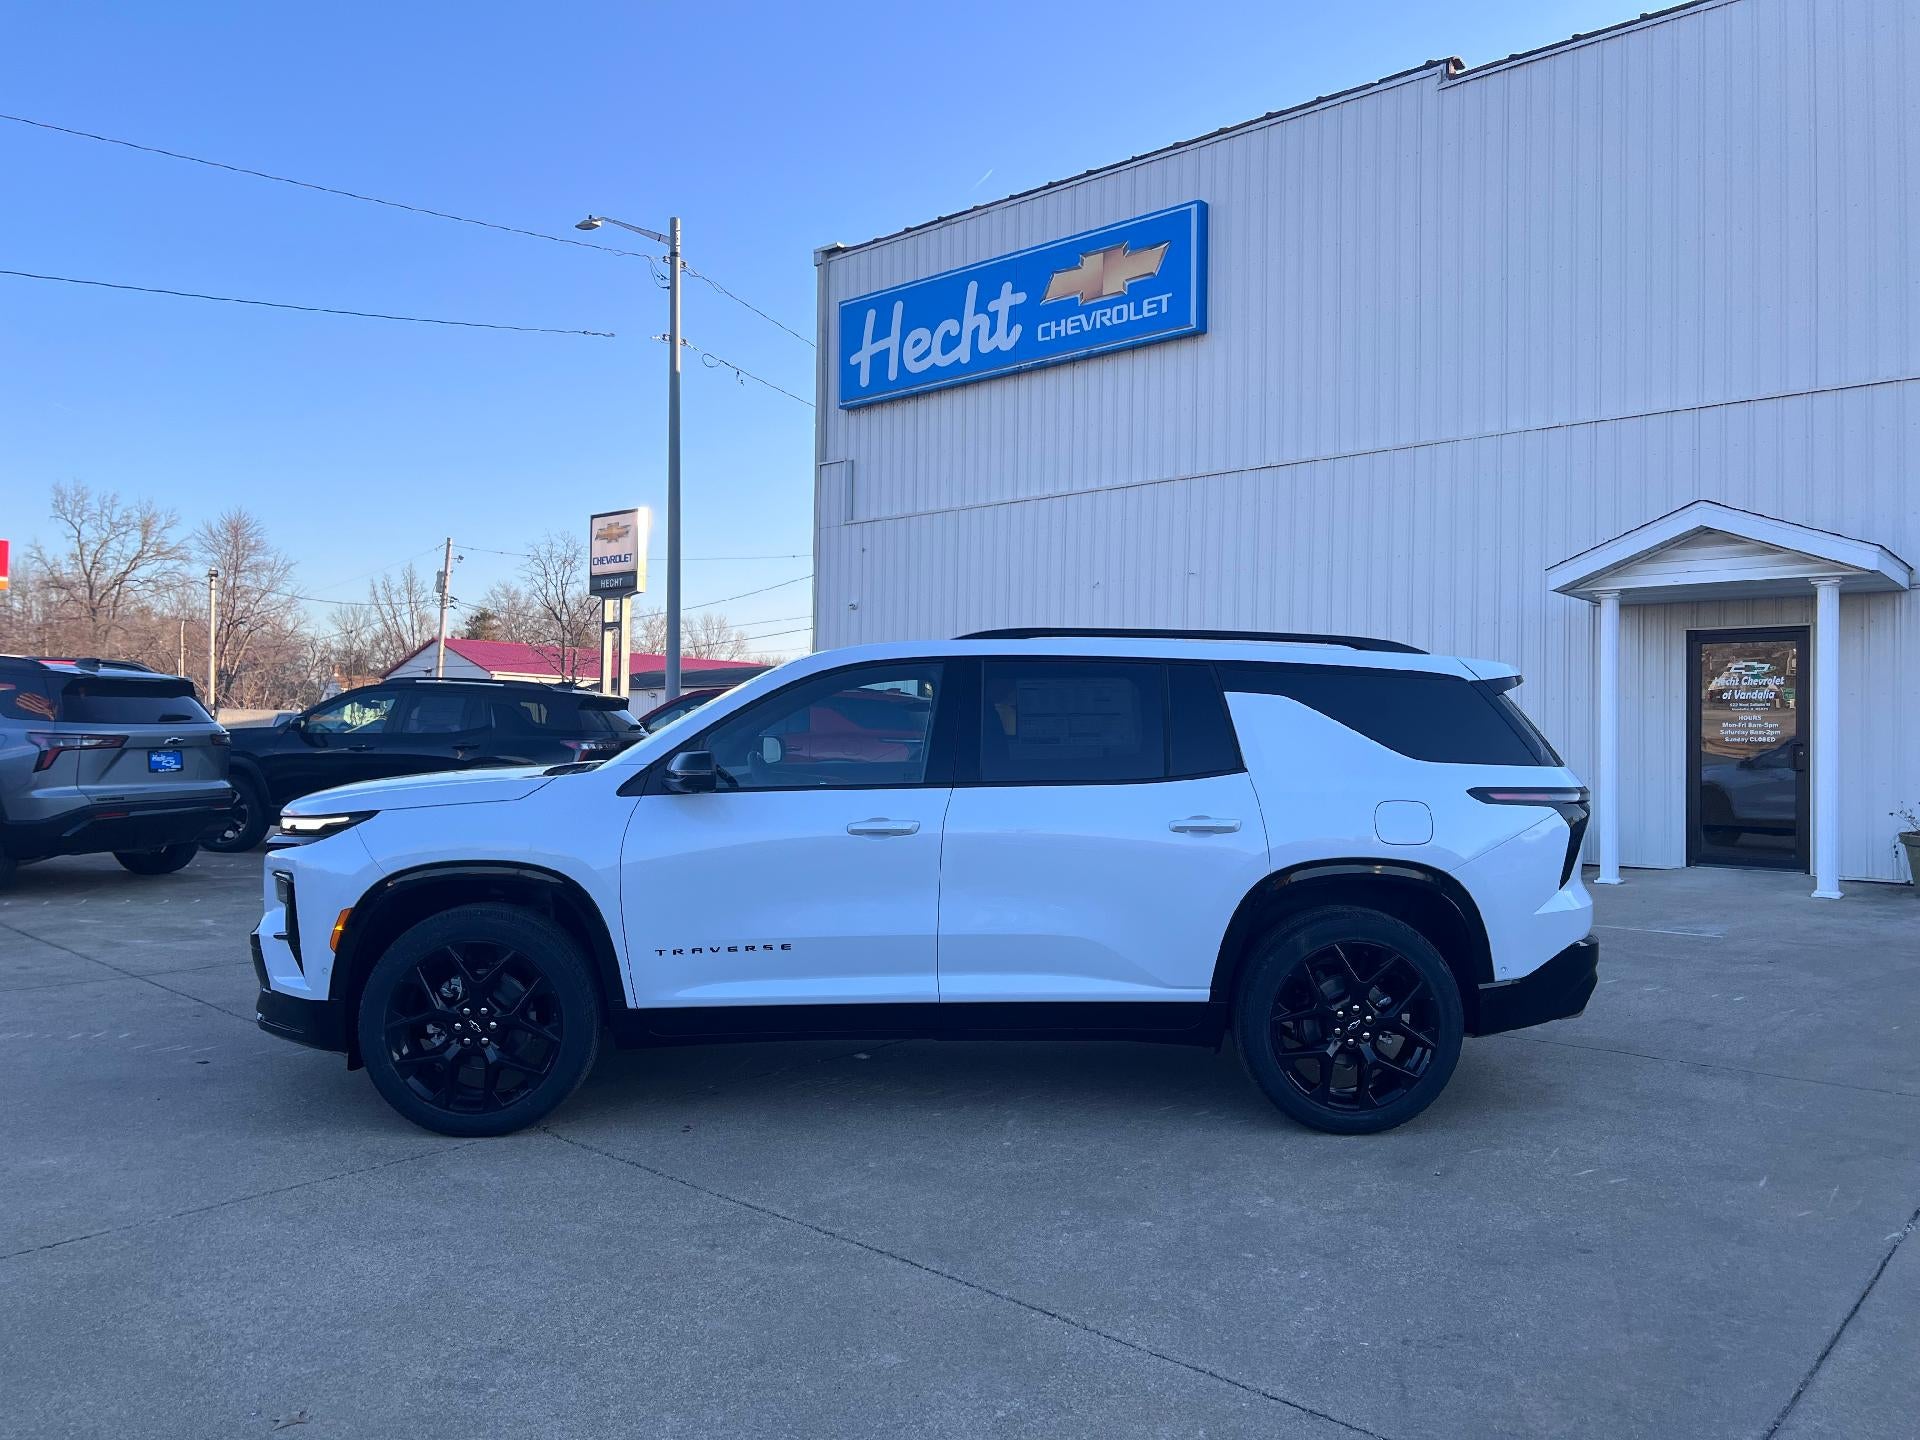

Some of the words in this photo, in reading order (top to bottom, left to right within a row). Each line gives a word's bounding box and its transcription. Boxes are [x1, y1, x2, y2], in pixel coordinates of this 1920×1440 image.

[1037, 292, 1173, 342] CHEVROLET
[850, 280, 1028, 388] Hecht
[592, 553, 633, 566] CHEVROLET
[600, 578, 623, 588] HECHT
[1741, 676, 1785, 686] Chevrolet
[1722, 690, 1733, 700] of
[1734, 690, 1776, 699] Vandalia
[1724, 736, 1749, 744] Sunday
[654, 943, 793, 957] TRAVERSE
